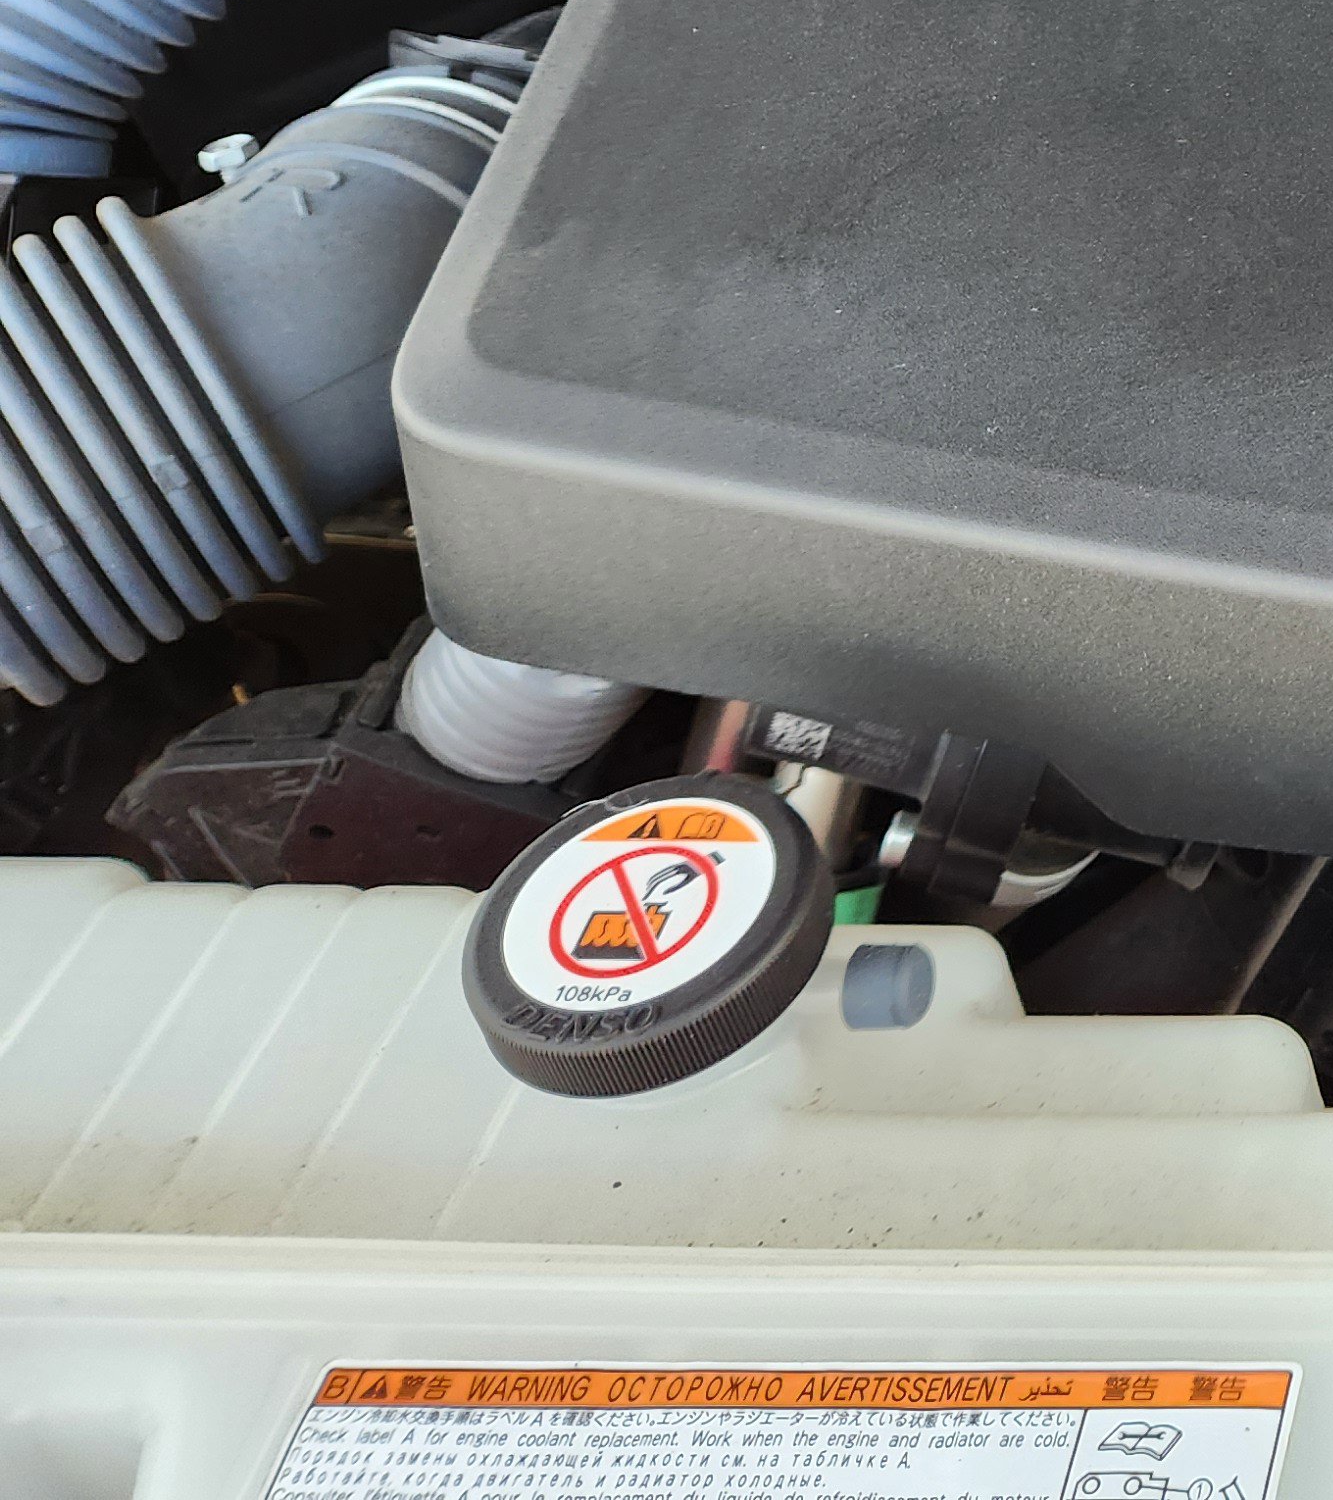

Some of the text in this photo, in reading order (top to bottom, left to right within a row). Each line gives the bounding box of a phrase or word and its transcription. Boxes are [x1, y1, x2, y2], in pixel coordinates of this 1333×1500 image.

[553, 985, 632, 1003] 108kPa
[502, 1002, 664, 1044] DENSO
[323, 1374, 350, 1400] B
[394, 1374, 453, 1400] 警告
[466, 1375, 591, 1402] WARNING
[607, 1375, 784, 1403] ОСТОРОЖНО
[795, 1375, 1016, 1403] AVERTISSEMENT
[1101, 1376, 1160, 1402] 警告
[1188, 1376, 1248, 1402] 警告
[300, 1427, 1071, 1450] Check label A for engine coolant replacement. Work when the engine and radiator are cold.
[466, 1450, 604, 1468] охлаждающей
[611, 1452, 711, 1469] жидкости
[721, 1452, 748, 1468] см.
[757, 1452, 780, 1468] на
[792, 1449, 889, 1469] табличке
[402, 1472, 464, 1488] когда
[471, 1473, 584, 1488] двигатель
[595, 1475, 607, 1488] и
[614, 1473, 715, 1489] радиатор
[724, 1474, 827, 1490] холодные.
